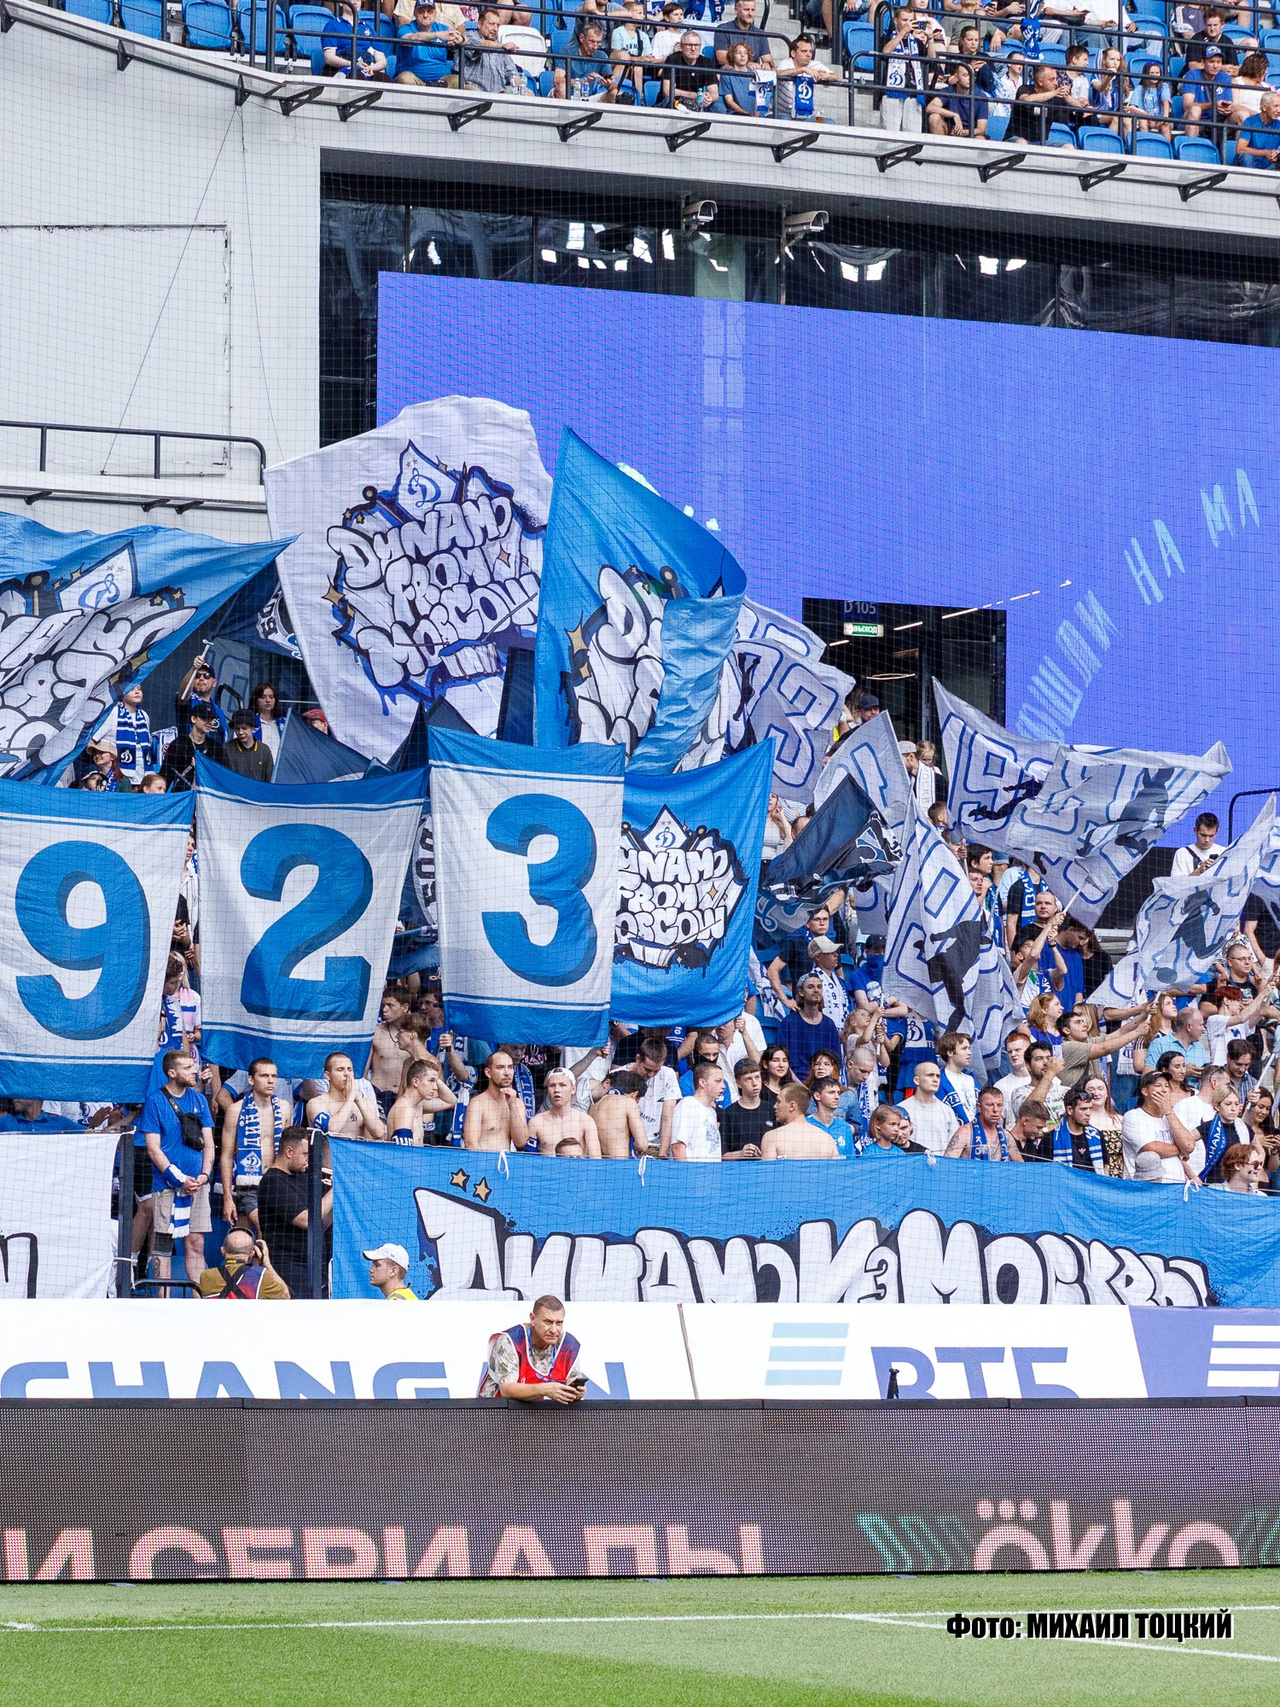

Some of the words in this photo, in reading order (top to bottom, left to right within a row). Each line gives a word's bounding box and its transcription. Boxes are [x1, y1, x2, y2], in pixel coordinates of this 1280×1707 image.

[327, 494, 514, 590] DYNAMO
[1124, 519, 1186, 606] НА
[385, 547, 492, 626] FROM
[855, 602, 877, 615] 105
[853, 624, 878, 634] ВЫХОД
[15, 840, 151, 1041] 9
[239, 822, 374, 1022] 2
[481, 793, 598, 987] 3
[414, 1187, 799, 1303] ДИНАМО
[796, 1217, 902, 1304] ИЗ
[0, 1361, 630, 1400] CHANGN
[870, 1346, 1082, 1399] ВТБ
[4, 1527, 95, 1582] И
[128, 1524, 764, 1581] СЕРИАЛЫ
